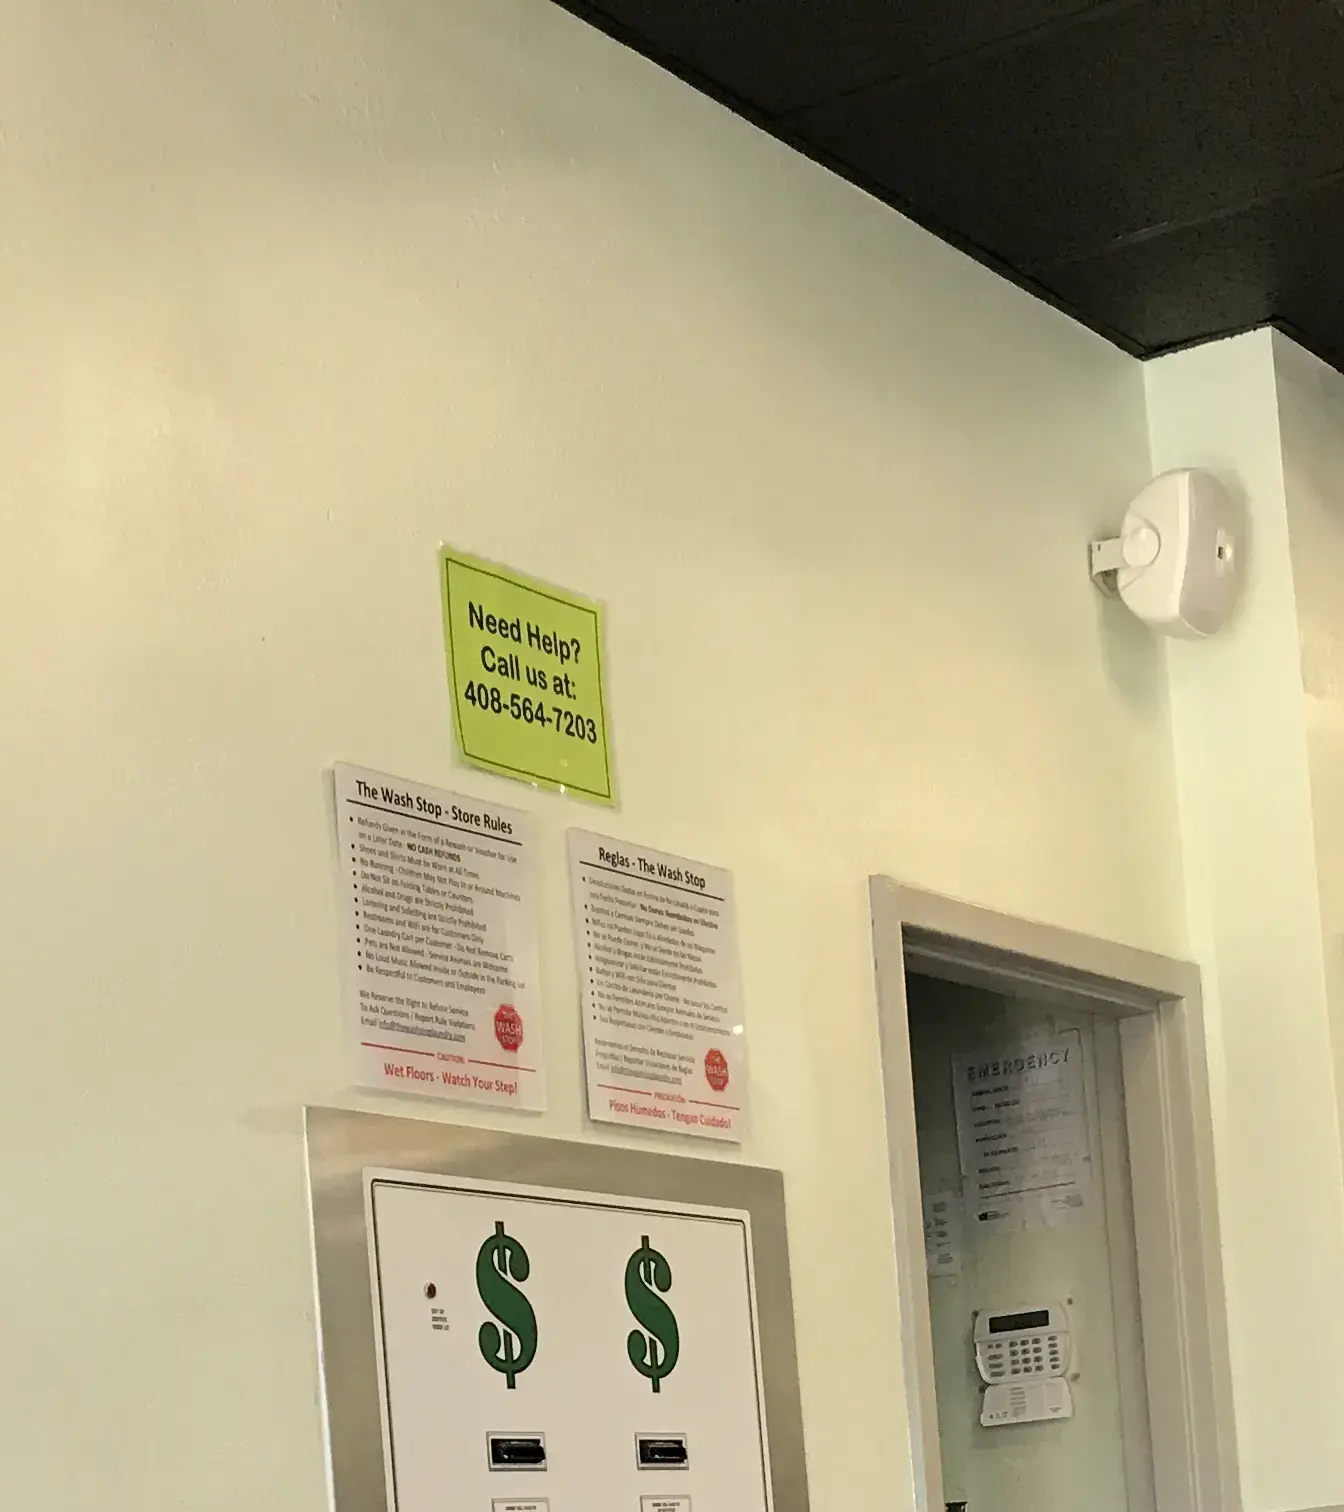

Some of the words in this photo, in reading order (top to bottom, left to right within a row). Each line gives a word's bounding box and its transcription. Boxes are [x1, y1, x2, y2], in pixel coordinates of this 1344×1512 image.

[469, 601, 522, 644] Need
[526, 621, 581, 665] Help?
[480, 645, 521, 682] Call
[525, 665, 548, 690] us
[552, 673, 577, 700] at:
[464, 680, 597, 744] 408-564-7203
[356, 779, 378, 800] The
[380, 785, 413, 809] Wash
[415, 795, 442, 819] Stop
[451, 804, 480, 827] Store
[482, 812, 512, 835] Rules
[598, 845, 630, 870] Reglas
[637, 856, 655, 875] The
[656, 862, 683, 882] Wash
[684, 869, 706, 891] Stop
[496, 1018, 521, 1036] WASH
[383, 1061, 403, 1077] Wet
[405, 1064, 434, 1082] Floors
[441, 1070, 470, 1087] Watch
[471, 1075, 493, 1090] Your
[494, 1078, 518, 1096] Step!
[609, 1098, 629, 1113] Pisos
